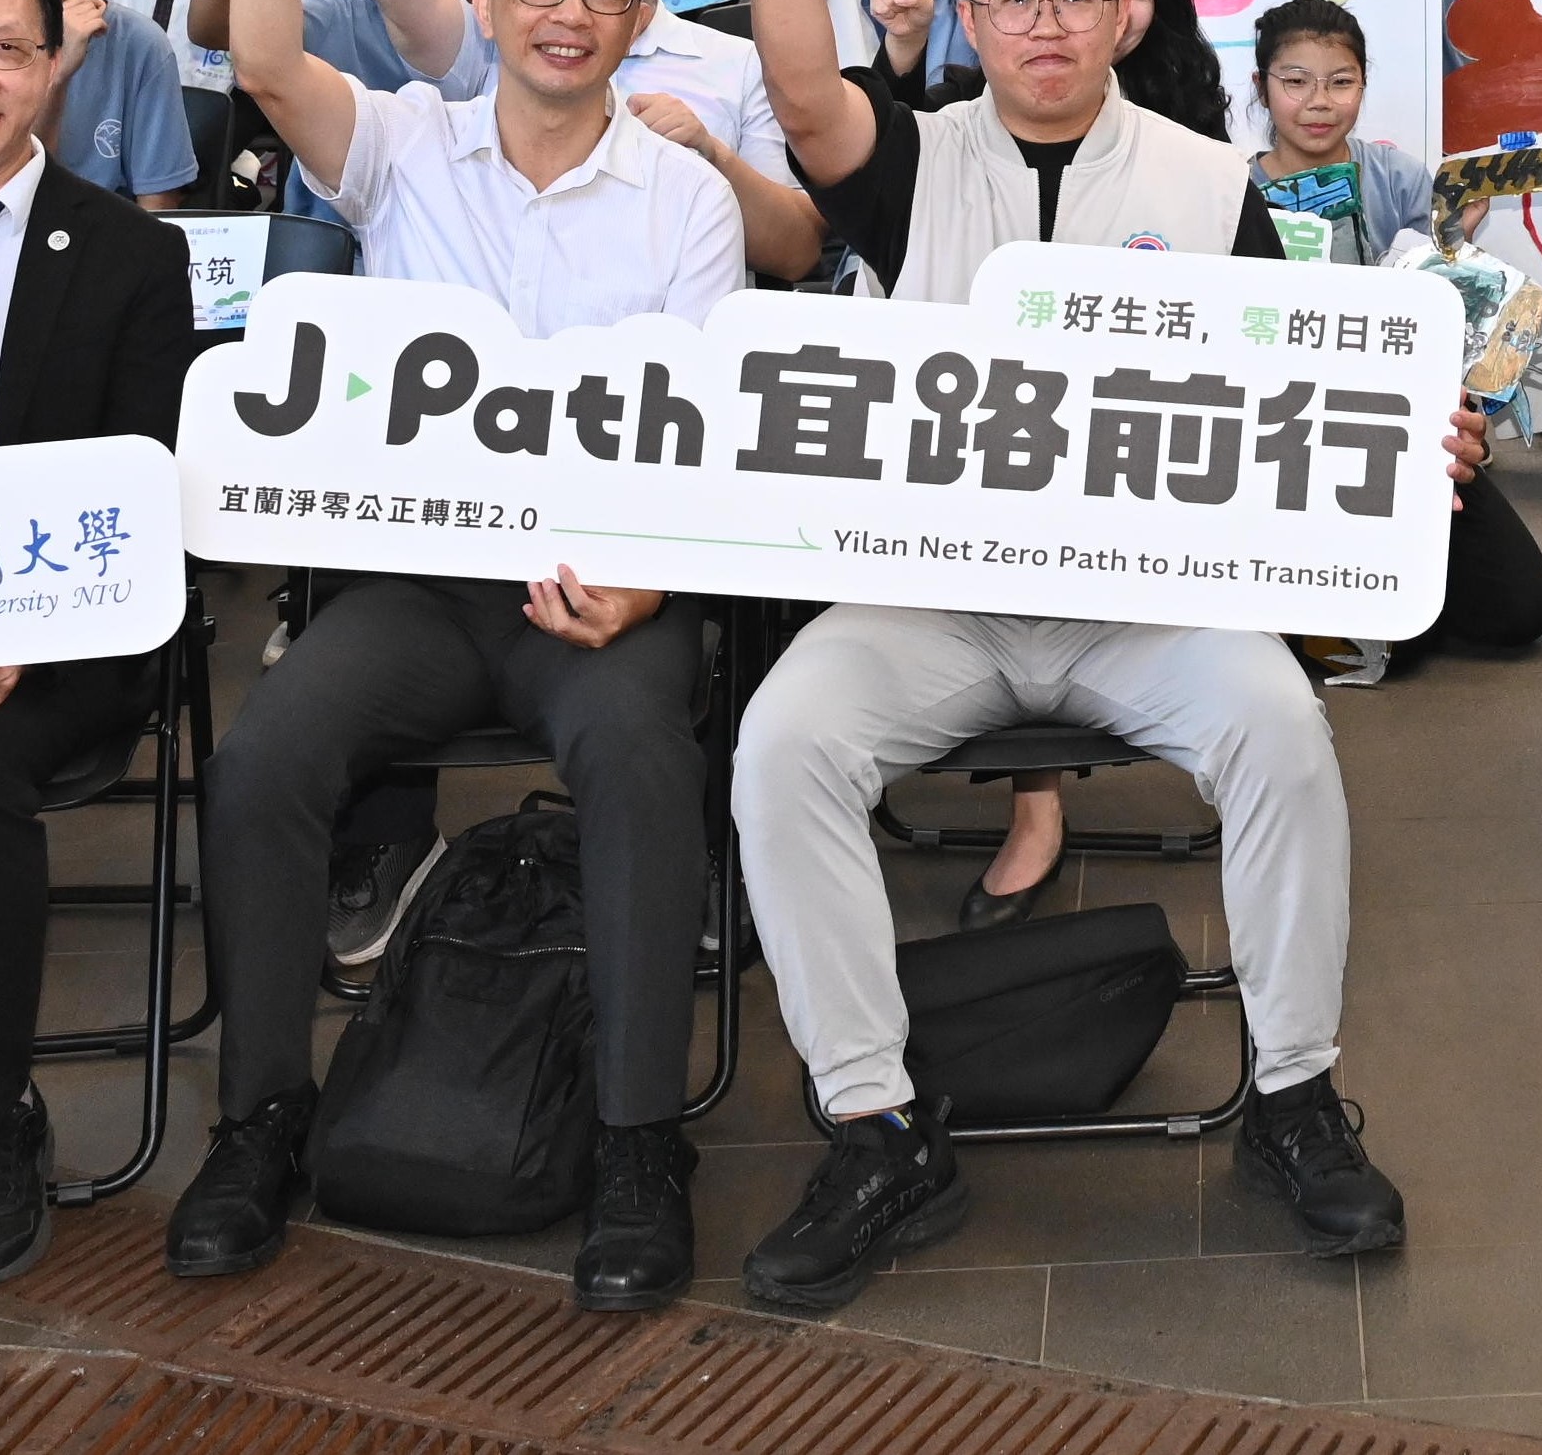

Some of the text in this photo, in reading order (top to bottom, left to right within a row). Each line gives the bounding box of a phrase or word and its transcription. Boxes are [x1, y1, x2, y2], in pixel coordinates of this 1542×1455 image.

[233, 322, 1413, 519] J Path 宜路前行
[218, 483, 539, 532] 宜蘭淨零公正轉型2.0
[833, 529, 1401, 593] Yilan Net Zero Path to Just Transition
[72, 579, 133, 609] NIU
